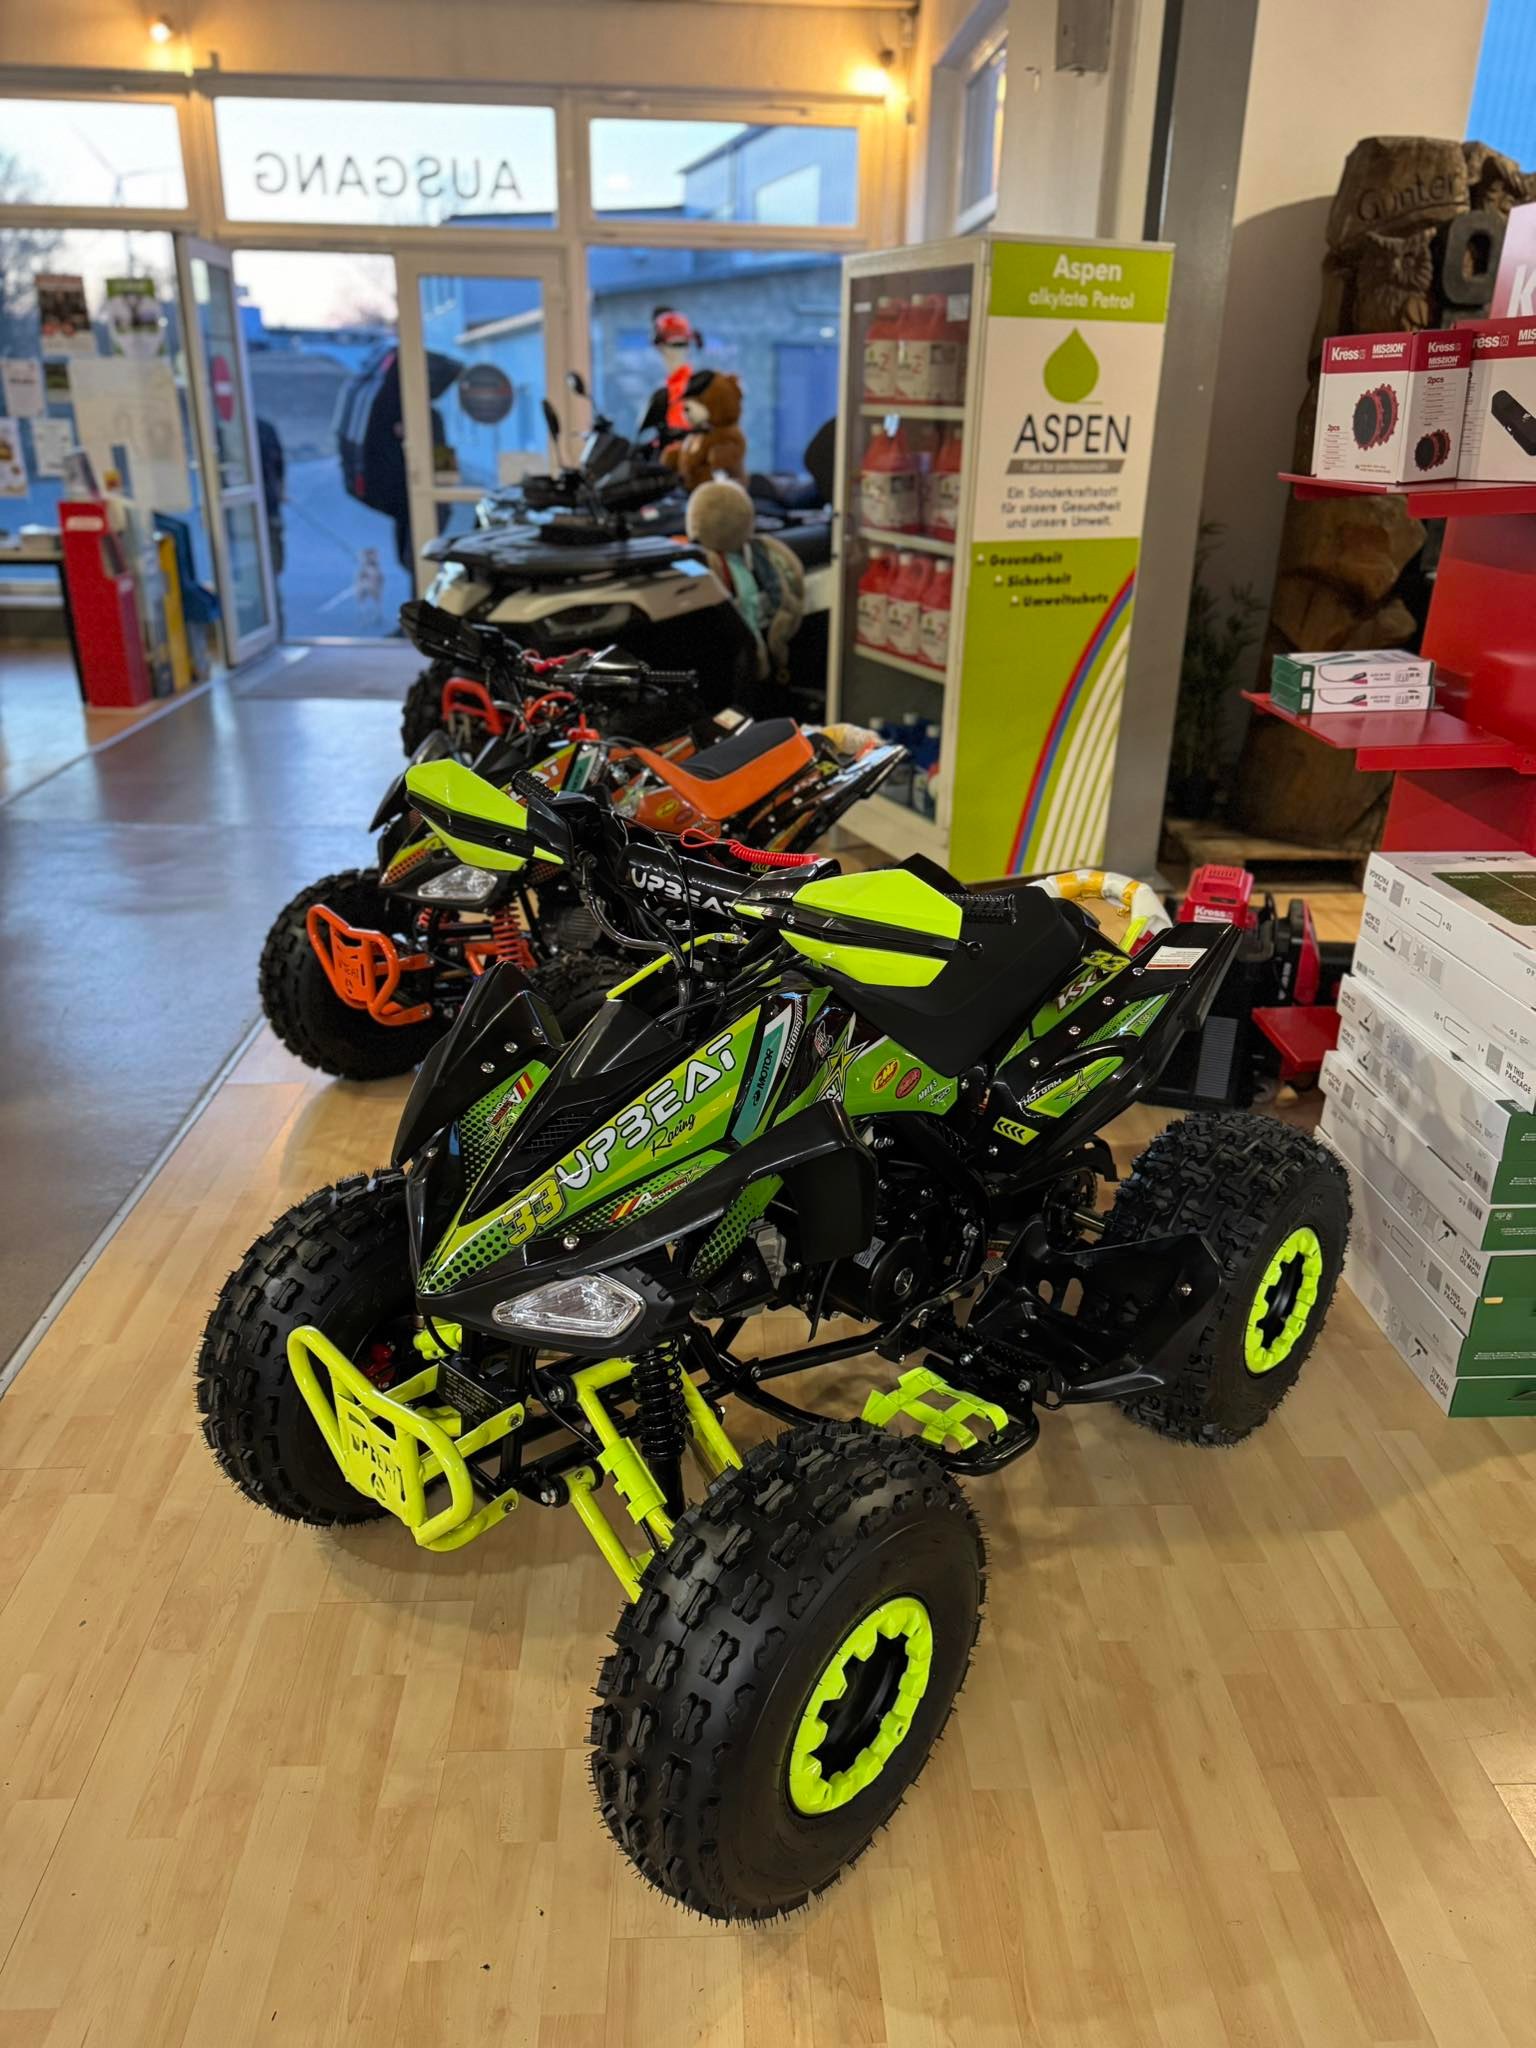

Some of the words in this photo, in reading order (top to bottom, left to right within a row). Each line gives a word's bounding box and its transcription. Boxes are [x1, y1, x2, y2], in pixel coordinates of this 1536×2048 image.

[1053, 253, 1122, 286] Aspen
[1028, 288, 1088, 310] alkylate
[1092, 290, 1135, 309] Petrol
[1428, 342, 1455, 353] Kress
[1473, 335, 1499, 349] ress
[1331, 347, 1359, 361] Kress
[1013, 413, 1130, 453] ASPEN
[1007, 488, 1025, 499] Ein
[1029, 486, 1118, 500] Sonderkraftstoff
[1020, 504, 1057, 514] unsere
[1062, 501, 1120, 512] Gesundheit
[1006, 518, 1026, 529] und
[989, 552, 1063, 567] Gesundheit
[1007, 573, 1071, 588] Sicherheit
[631, 867, 736, 918] UPBEAT
[759, 1047, 774, 1090] MOTOR
[1507, 1061, 1513, 1072] IN
[1512, 1065, 1525, 1080] THIS
[1505, 1070, 1532, 1095] PACKAGE
[554, 1032, 736, 1190] UPBEAT
[643, 1113, 696, 1158] Racing
[501, 1177, 566, 1247] 33
